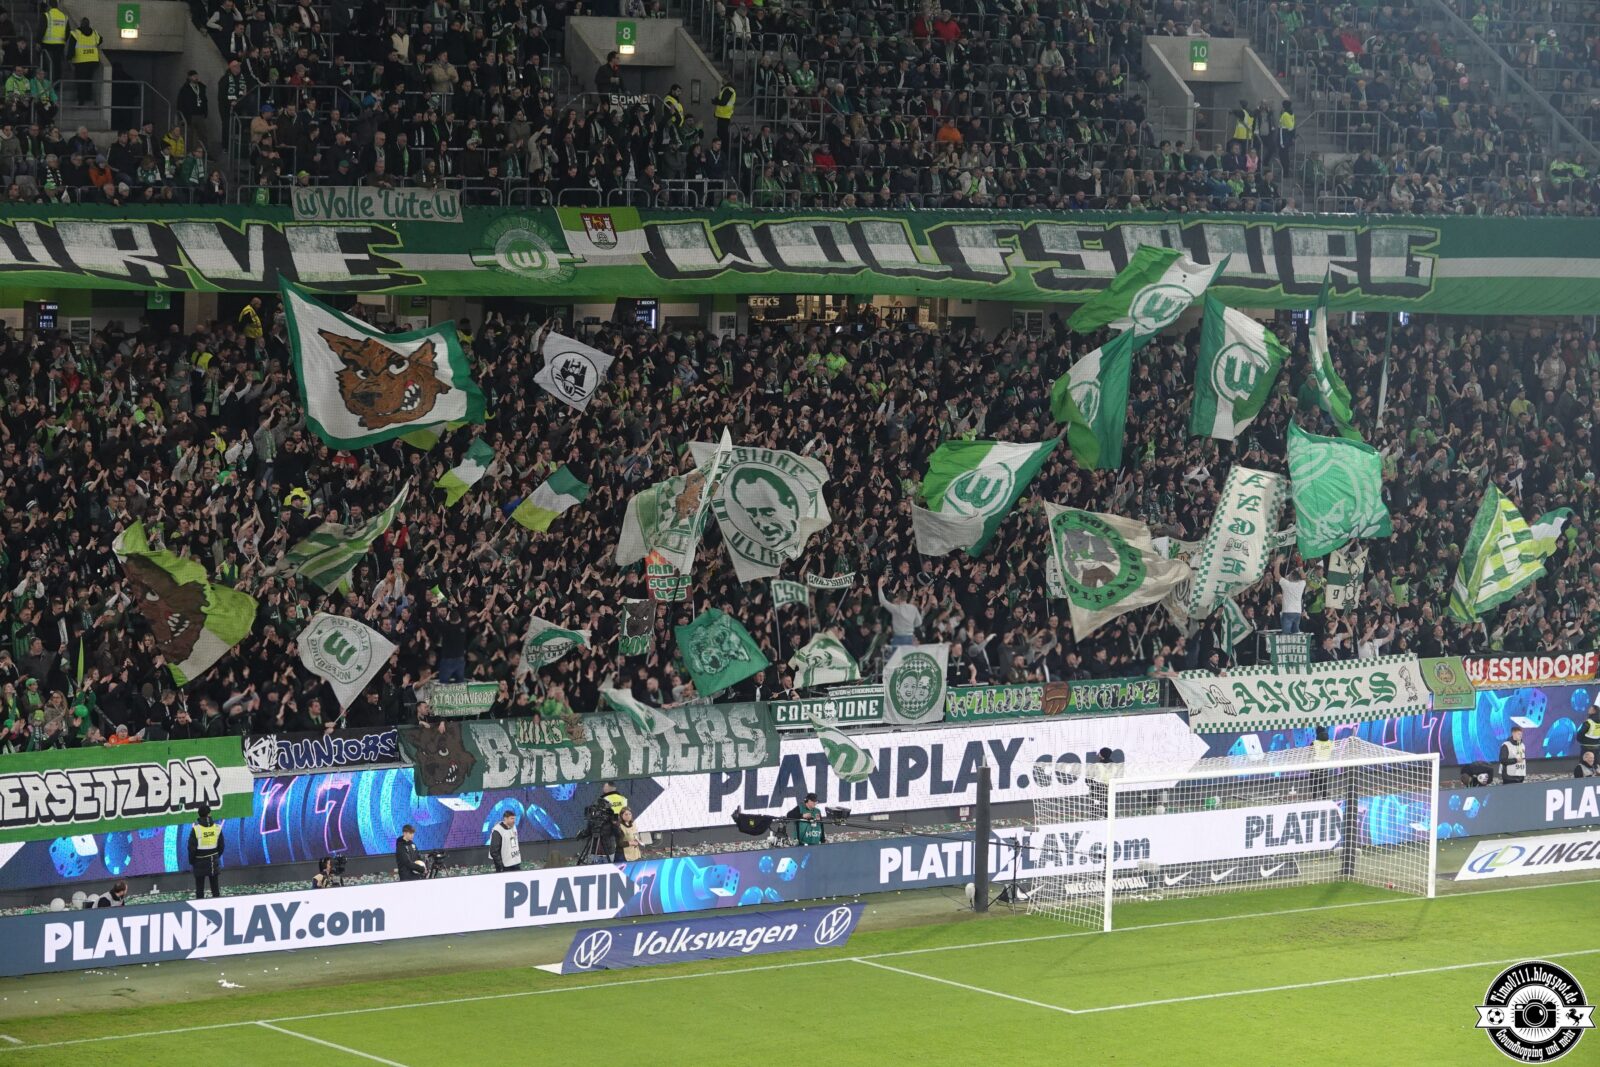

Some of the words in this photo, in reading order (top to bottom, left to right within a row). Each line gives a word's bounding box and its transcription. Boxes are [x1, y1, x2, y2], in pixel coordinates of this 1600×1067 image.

[124, 10, 134, 23] 6
[623, 27, 631, 40] 8
[1192, 45, 1207, 59] 10
[315, 187, 375, 219] Volle
[1466, 652, 1595, 682] WESENDORF
[1232, 671, 1398, 717] ANGELS
[276, 729, 398, 770] JUNIORS
[1546, 786, 1600, 822] PLA
[1522, 841, 1600, 867] LINGL
[504, 871, 636, 919] PLATIN
[44, 901, 385, 963] PLATINPLAY.com
[633, 923, 799, 953] Volkswagen
